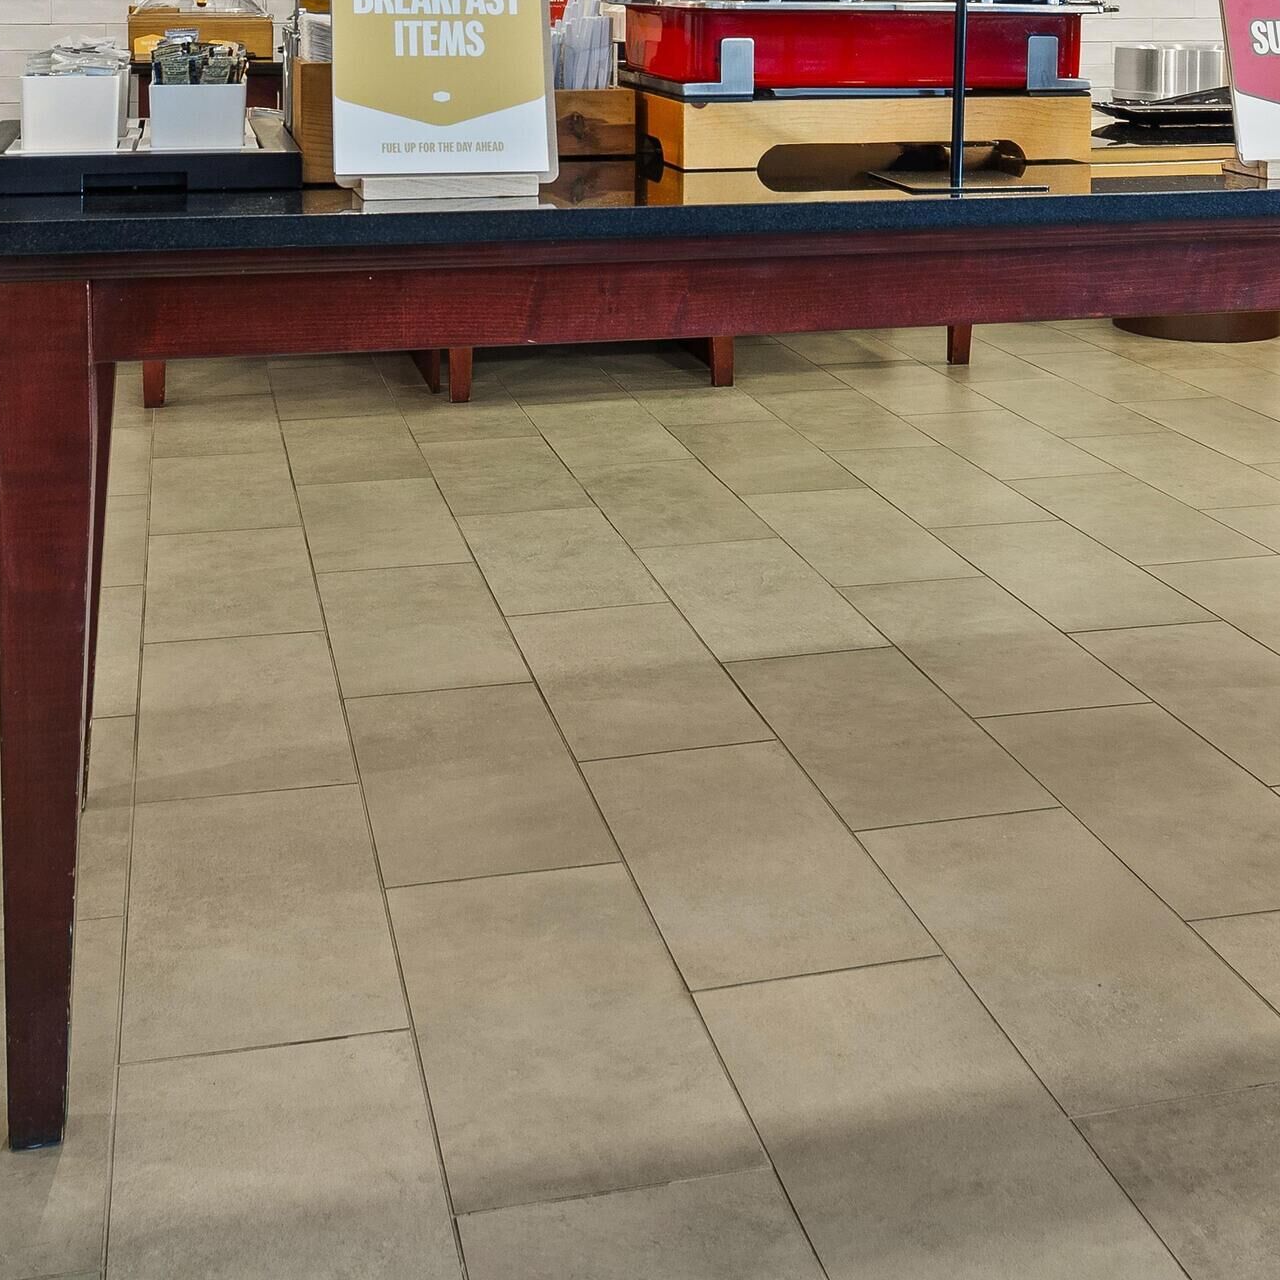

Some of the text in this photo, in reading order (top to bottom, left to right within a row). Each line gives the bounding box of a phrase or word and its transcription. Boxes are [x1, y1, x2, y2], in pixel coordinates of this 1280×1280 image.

[394, 20, 485, 57] ITEMS
[381, 141, 505, 153] FUEL UP FOR THE DAY AHEAD
